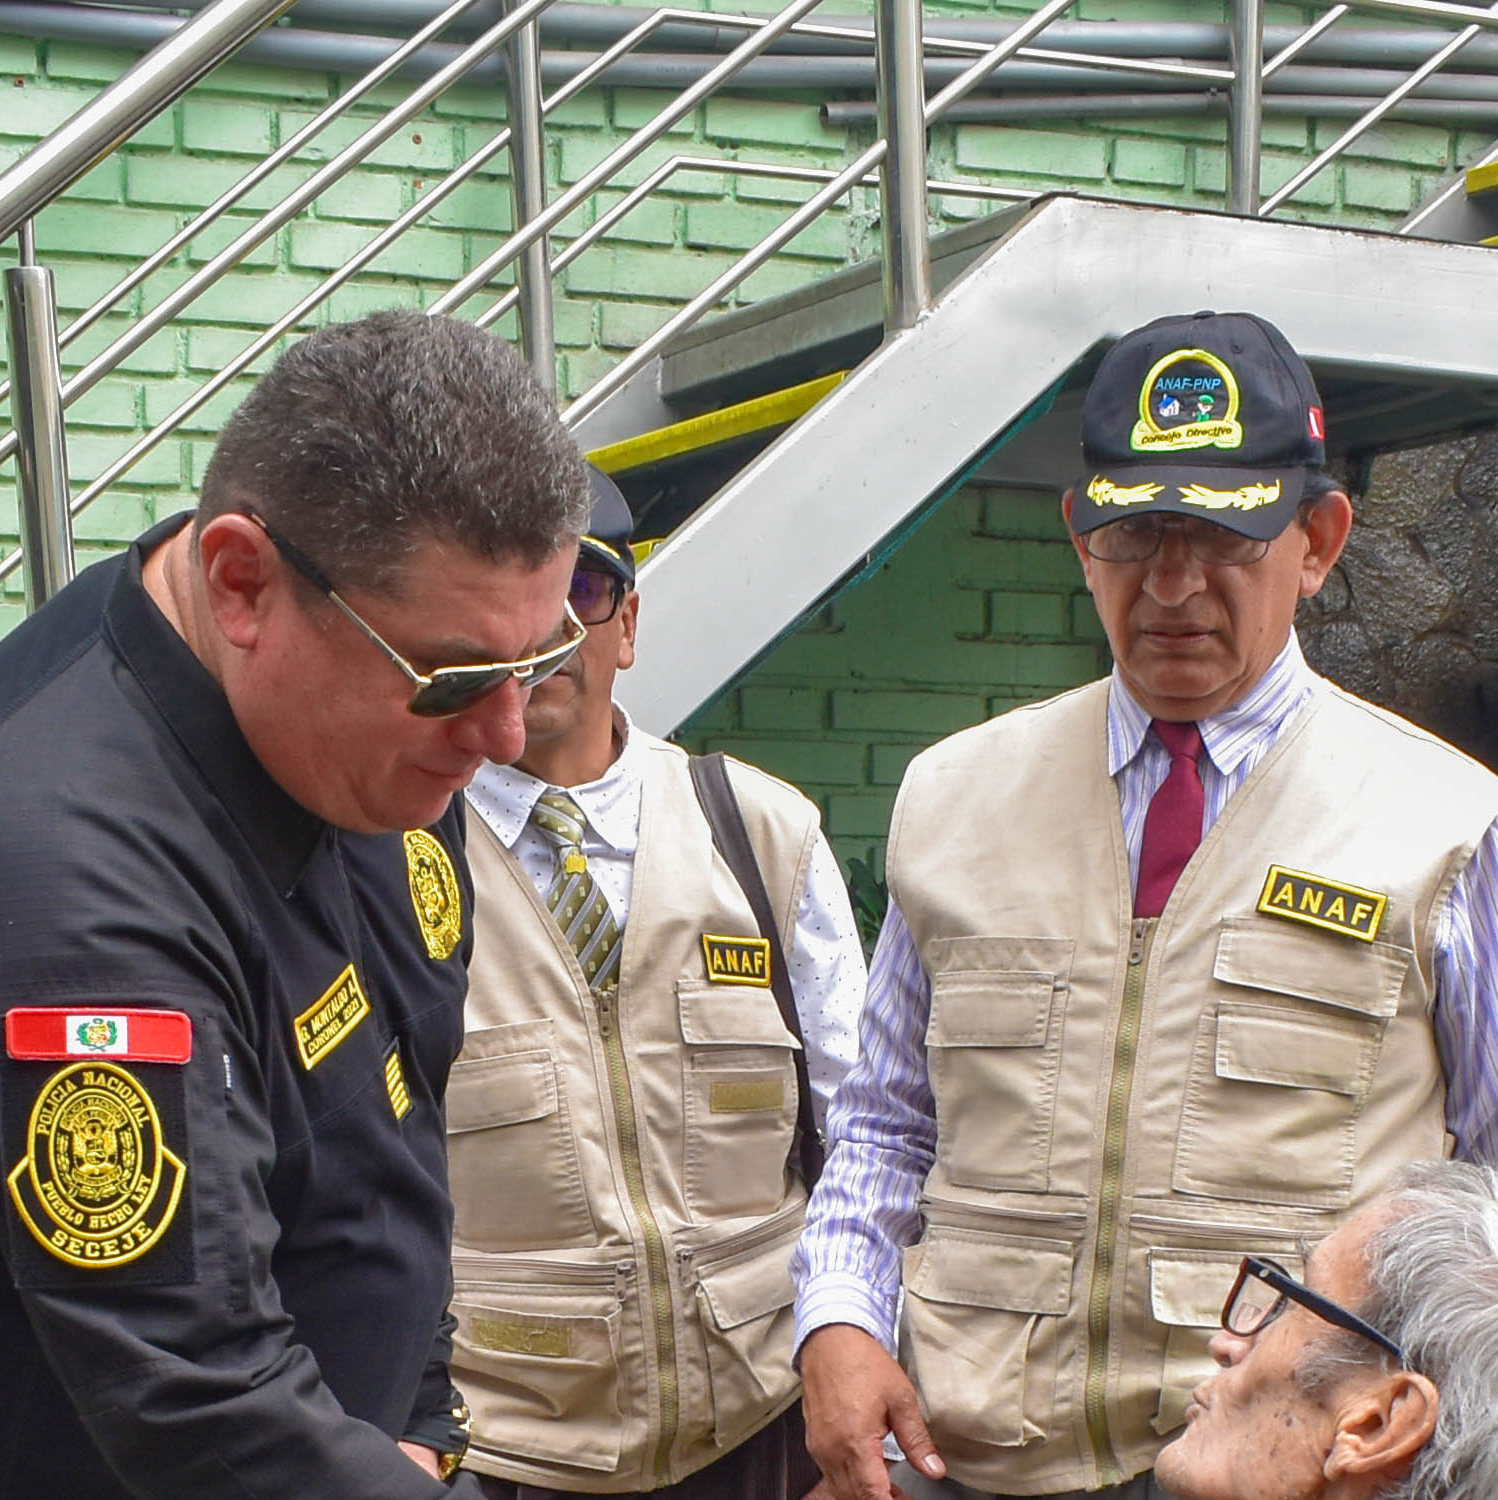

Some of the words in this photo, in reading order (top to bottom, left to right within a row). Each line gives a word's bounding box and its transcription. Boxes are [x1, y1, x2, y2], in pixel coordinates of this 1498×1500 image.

[1155, 377, 1222, 391] ANAF-PNP
[1272, 881, 1373, 927] ANAF
[713, 947, 764, 975] ANAF
[308, 1017, 343, 1054] CORONEL
[37, 1079, 78, 1136] POLICIA
[82, 1071, 150, 1128] NACIONAL
[41, 1181, 84, 1225] PUEBLO
[88, 1202, 134, 1229] HECHO
[132, 1174, 152, 1204] LEY
[51, 1220, 153, 1258] SECEJE
